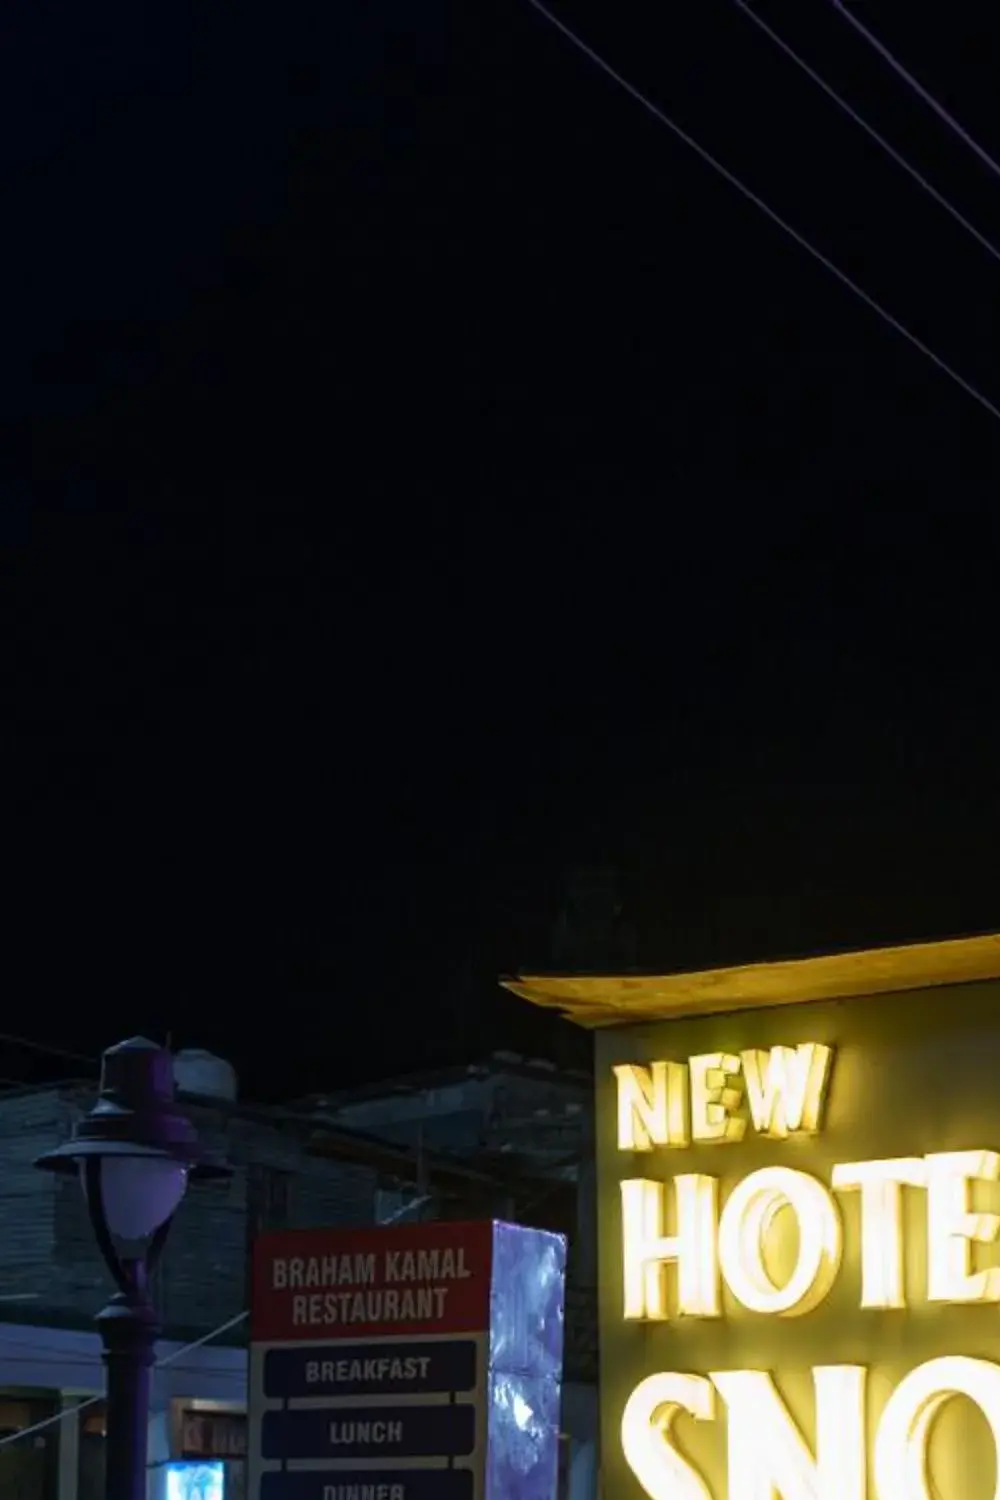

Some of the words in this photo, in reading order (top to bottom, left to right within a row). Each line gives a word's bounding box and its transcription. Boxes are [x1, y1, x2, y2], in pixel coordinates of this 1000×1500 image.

[612, 1042, 834, 1152] NEW
[272, 1253, 376, 1289] BRAHAM
[385, 1248, 472, 1282] KAMAL
[292, 1288, 448, 1326] RESTAURANT
[305, 1357, 431, 1383] BREAKFAST
[330, 1421, 403, 1444] LUNCH
